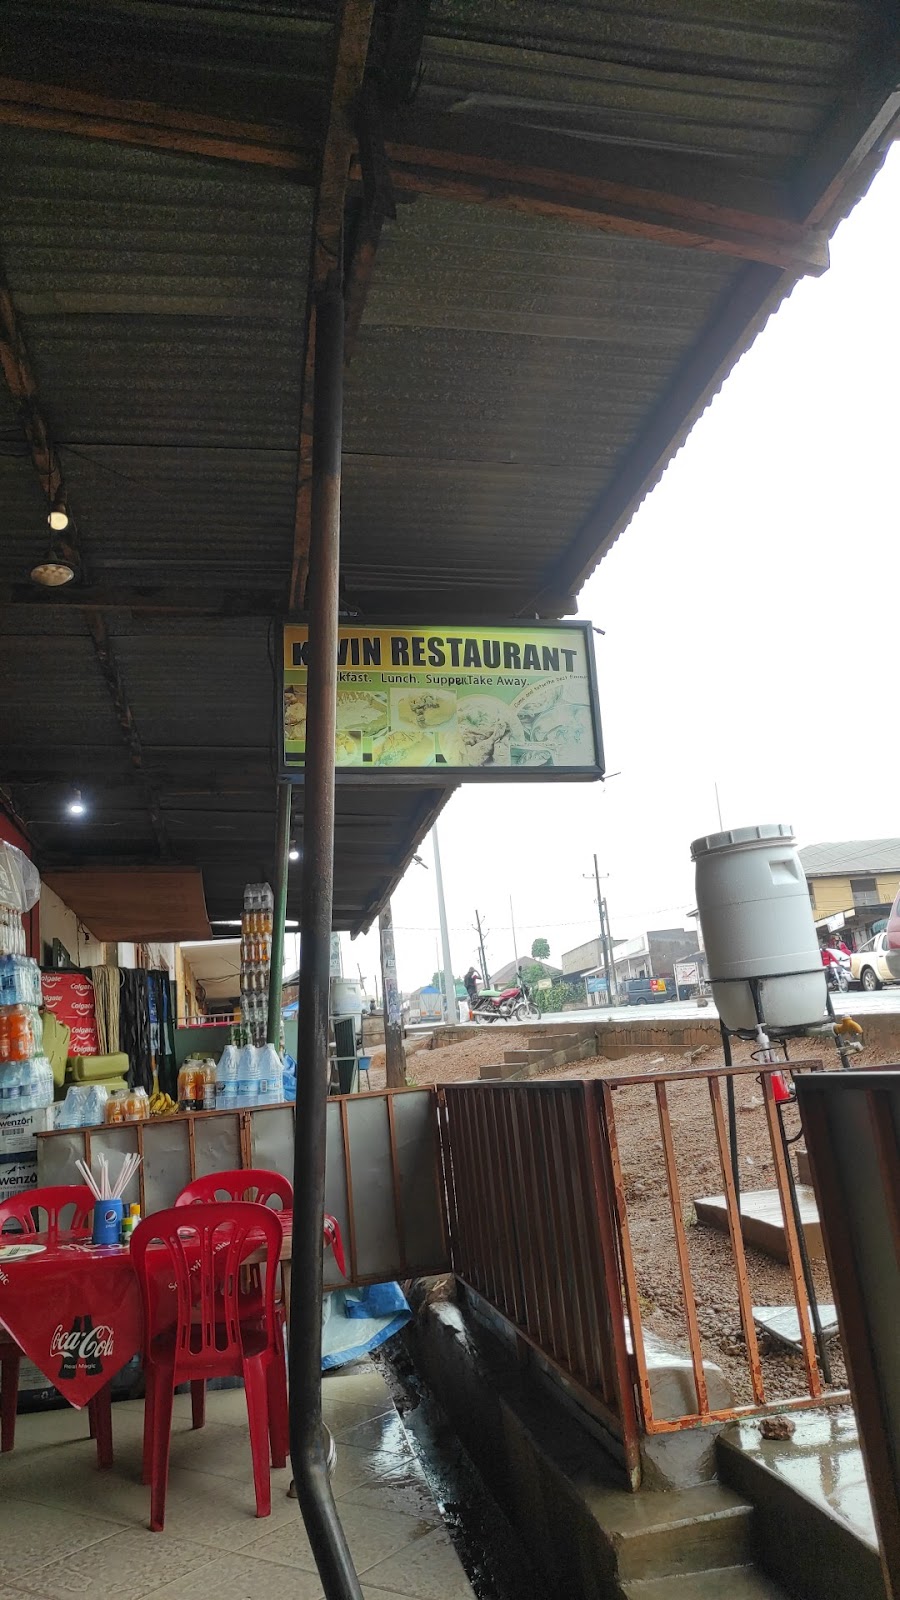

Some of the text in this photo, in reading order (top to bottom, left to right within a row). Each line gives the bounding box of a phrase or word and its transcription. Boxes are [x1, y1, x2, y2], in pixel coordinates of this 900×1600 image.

[292, 635, 577, 673] KVIN RESTAURANT
[380, 673, 420, 684] Lunch.
[466, 675, 493, 687] Take
[495, 676, 530, 689] Away.
[71, 1001, 94, 1011] Colgate
[71, 1026, 96, 1036] Colgate
[72, 1043, 97, 1054] Colgate
[50, 1324, 114, 1359] Coca-Cola
